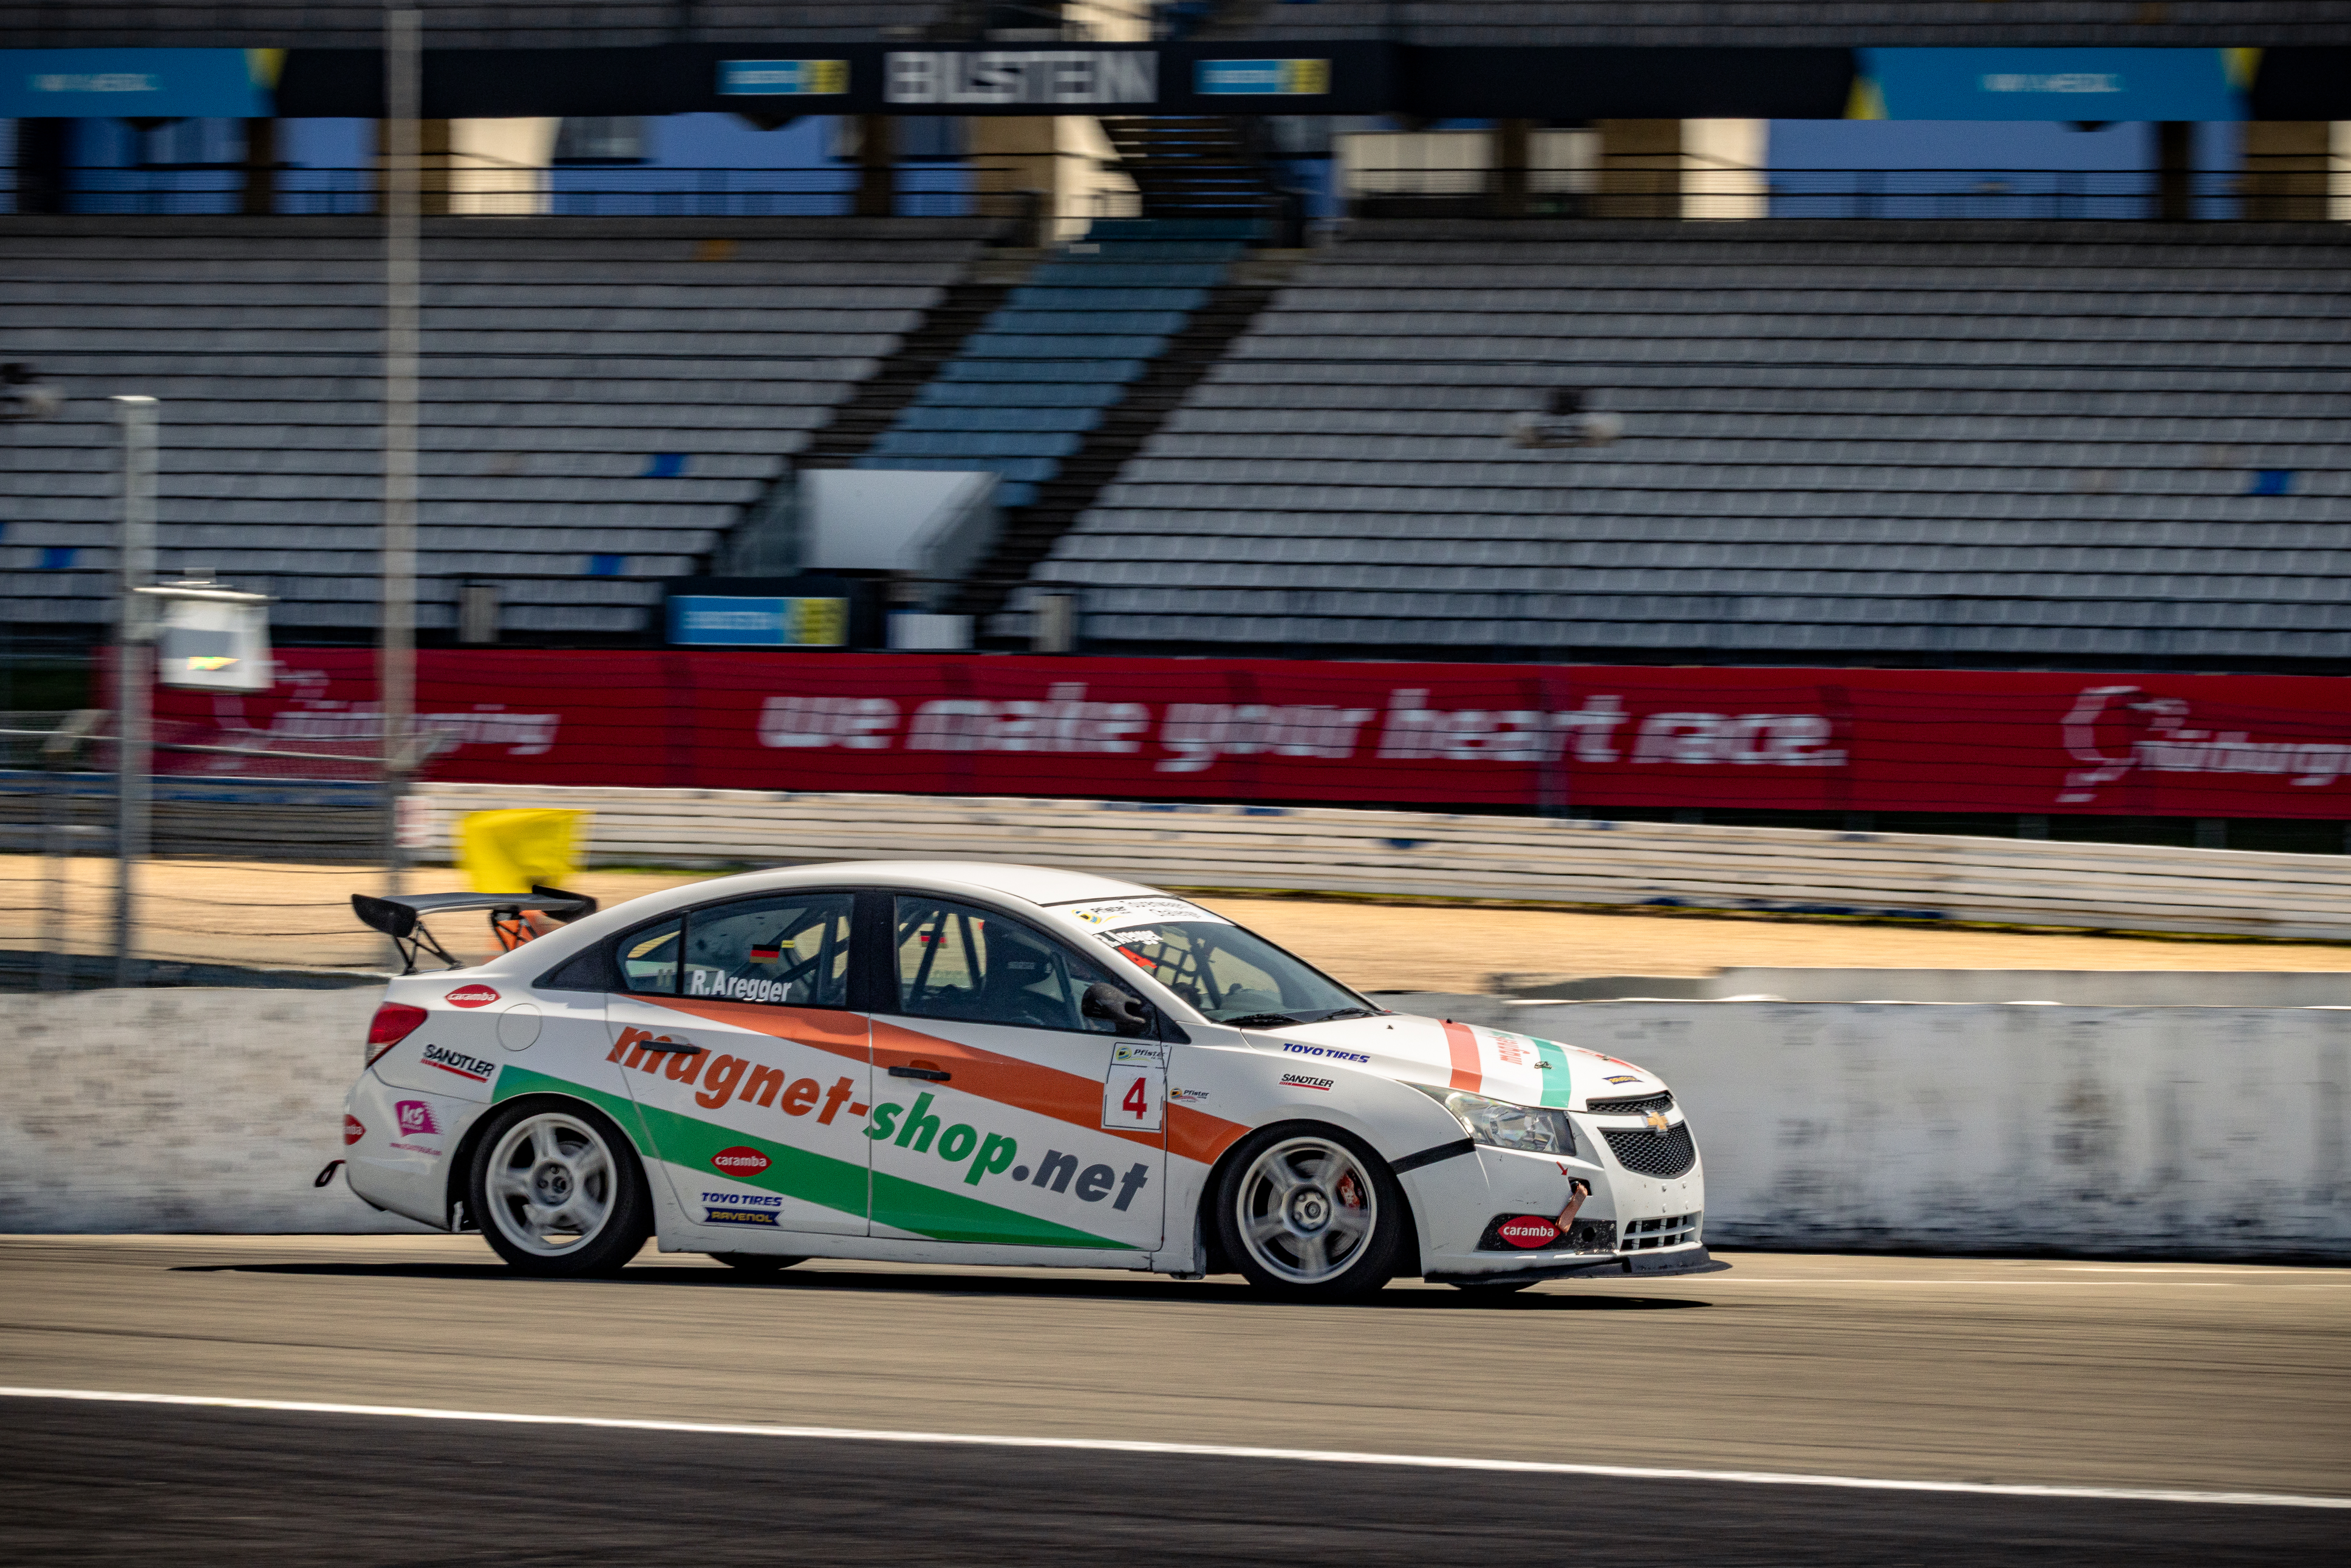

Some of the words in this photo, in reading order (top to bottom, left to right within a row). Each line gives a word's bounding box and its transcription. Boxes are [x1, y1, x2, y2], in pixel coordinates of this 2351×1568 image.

[757, 697, 901, 749] we
[904, 682, 1152, 753] make
[1154, 703, 1376, 773] your
[1375, 687, 1630, 763] heart
[690, 969, 793, 1002] R.Aregger
[447, 991, 496, 1001] caramba
[422, 1044, 496, 1077] SANDTLER
[1283, 1043, 1324, 1055] TOYO
[1326, 1049, 1371, 1063] TIRES
[1281, 1073, 1334, 1088] SANDTLER
[1122, 1077, 1148, 1120] 4
[605, 1026, 1149, 1212] magnet-shop.net
[714, 1154, 767, 1167] caramba
[701, 1191, 740, 1204] TOYO
[741, 1195, 783, 1207] TIRES
[1503, 1225, 1554, 1237] caramba
